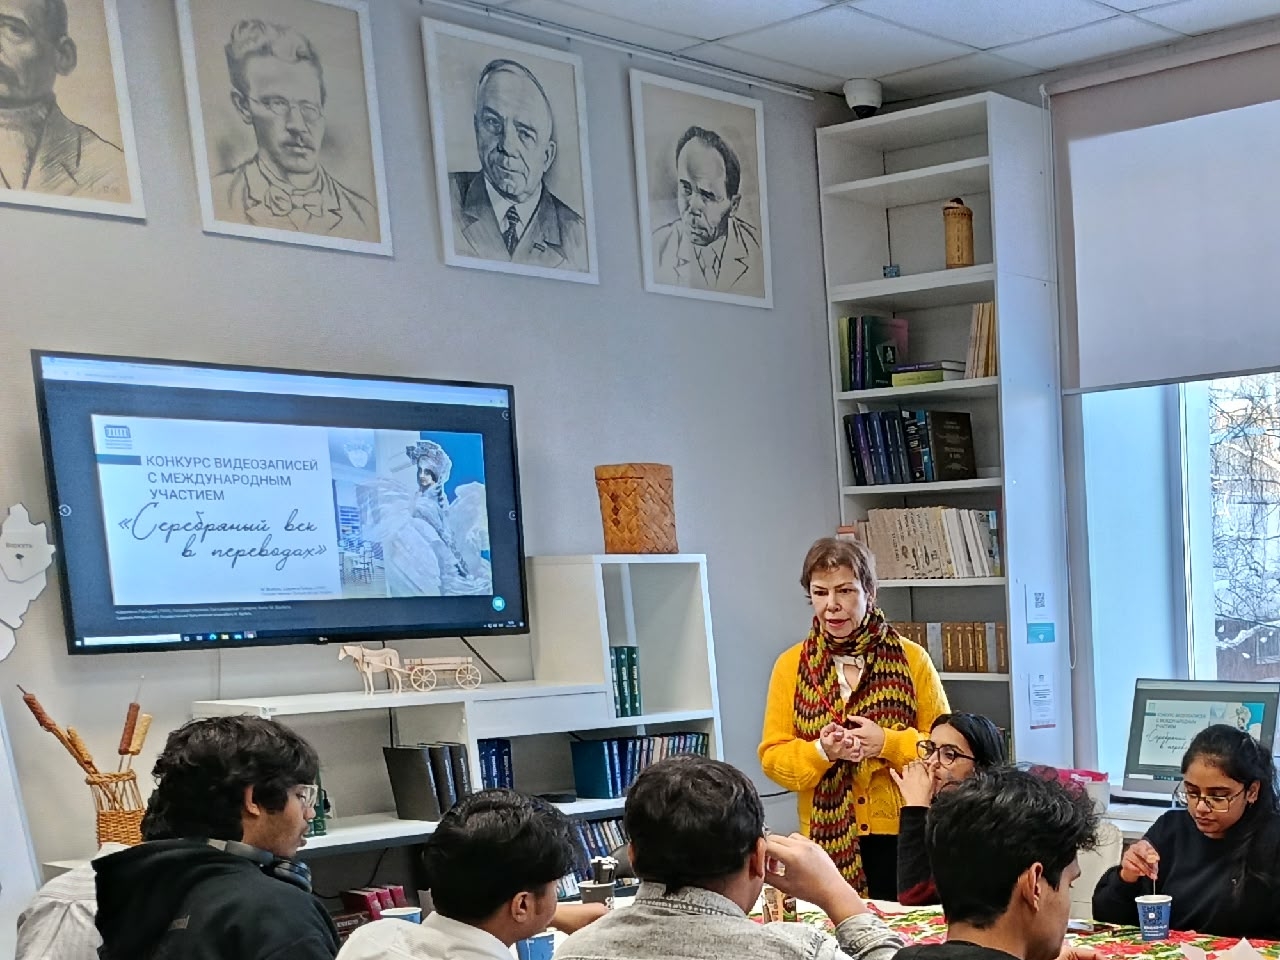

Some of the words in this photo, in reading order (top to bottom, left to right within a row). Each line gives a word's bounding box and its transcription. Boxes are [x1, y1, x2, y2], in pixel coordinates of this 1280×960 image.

[146, 455, 211, 468] КОНКУРС
[214, 456, 318, 471] ВИДЕОЗАПИСЕЙ
[148, 472, 157, 484] С
[161, 472, 292, 487] МЕЖДУНАРОДНЫМ
[149, 489, 225, 501] УЧАСТИЕМ
[118, 502, 270, 543] «Серебряный
[283, 508, 317, 532] век
[181, 534, 196, 558] в
[211, 534, 327, 571] переводах»
